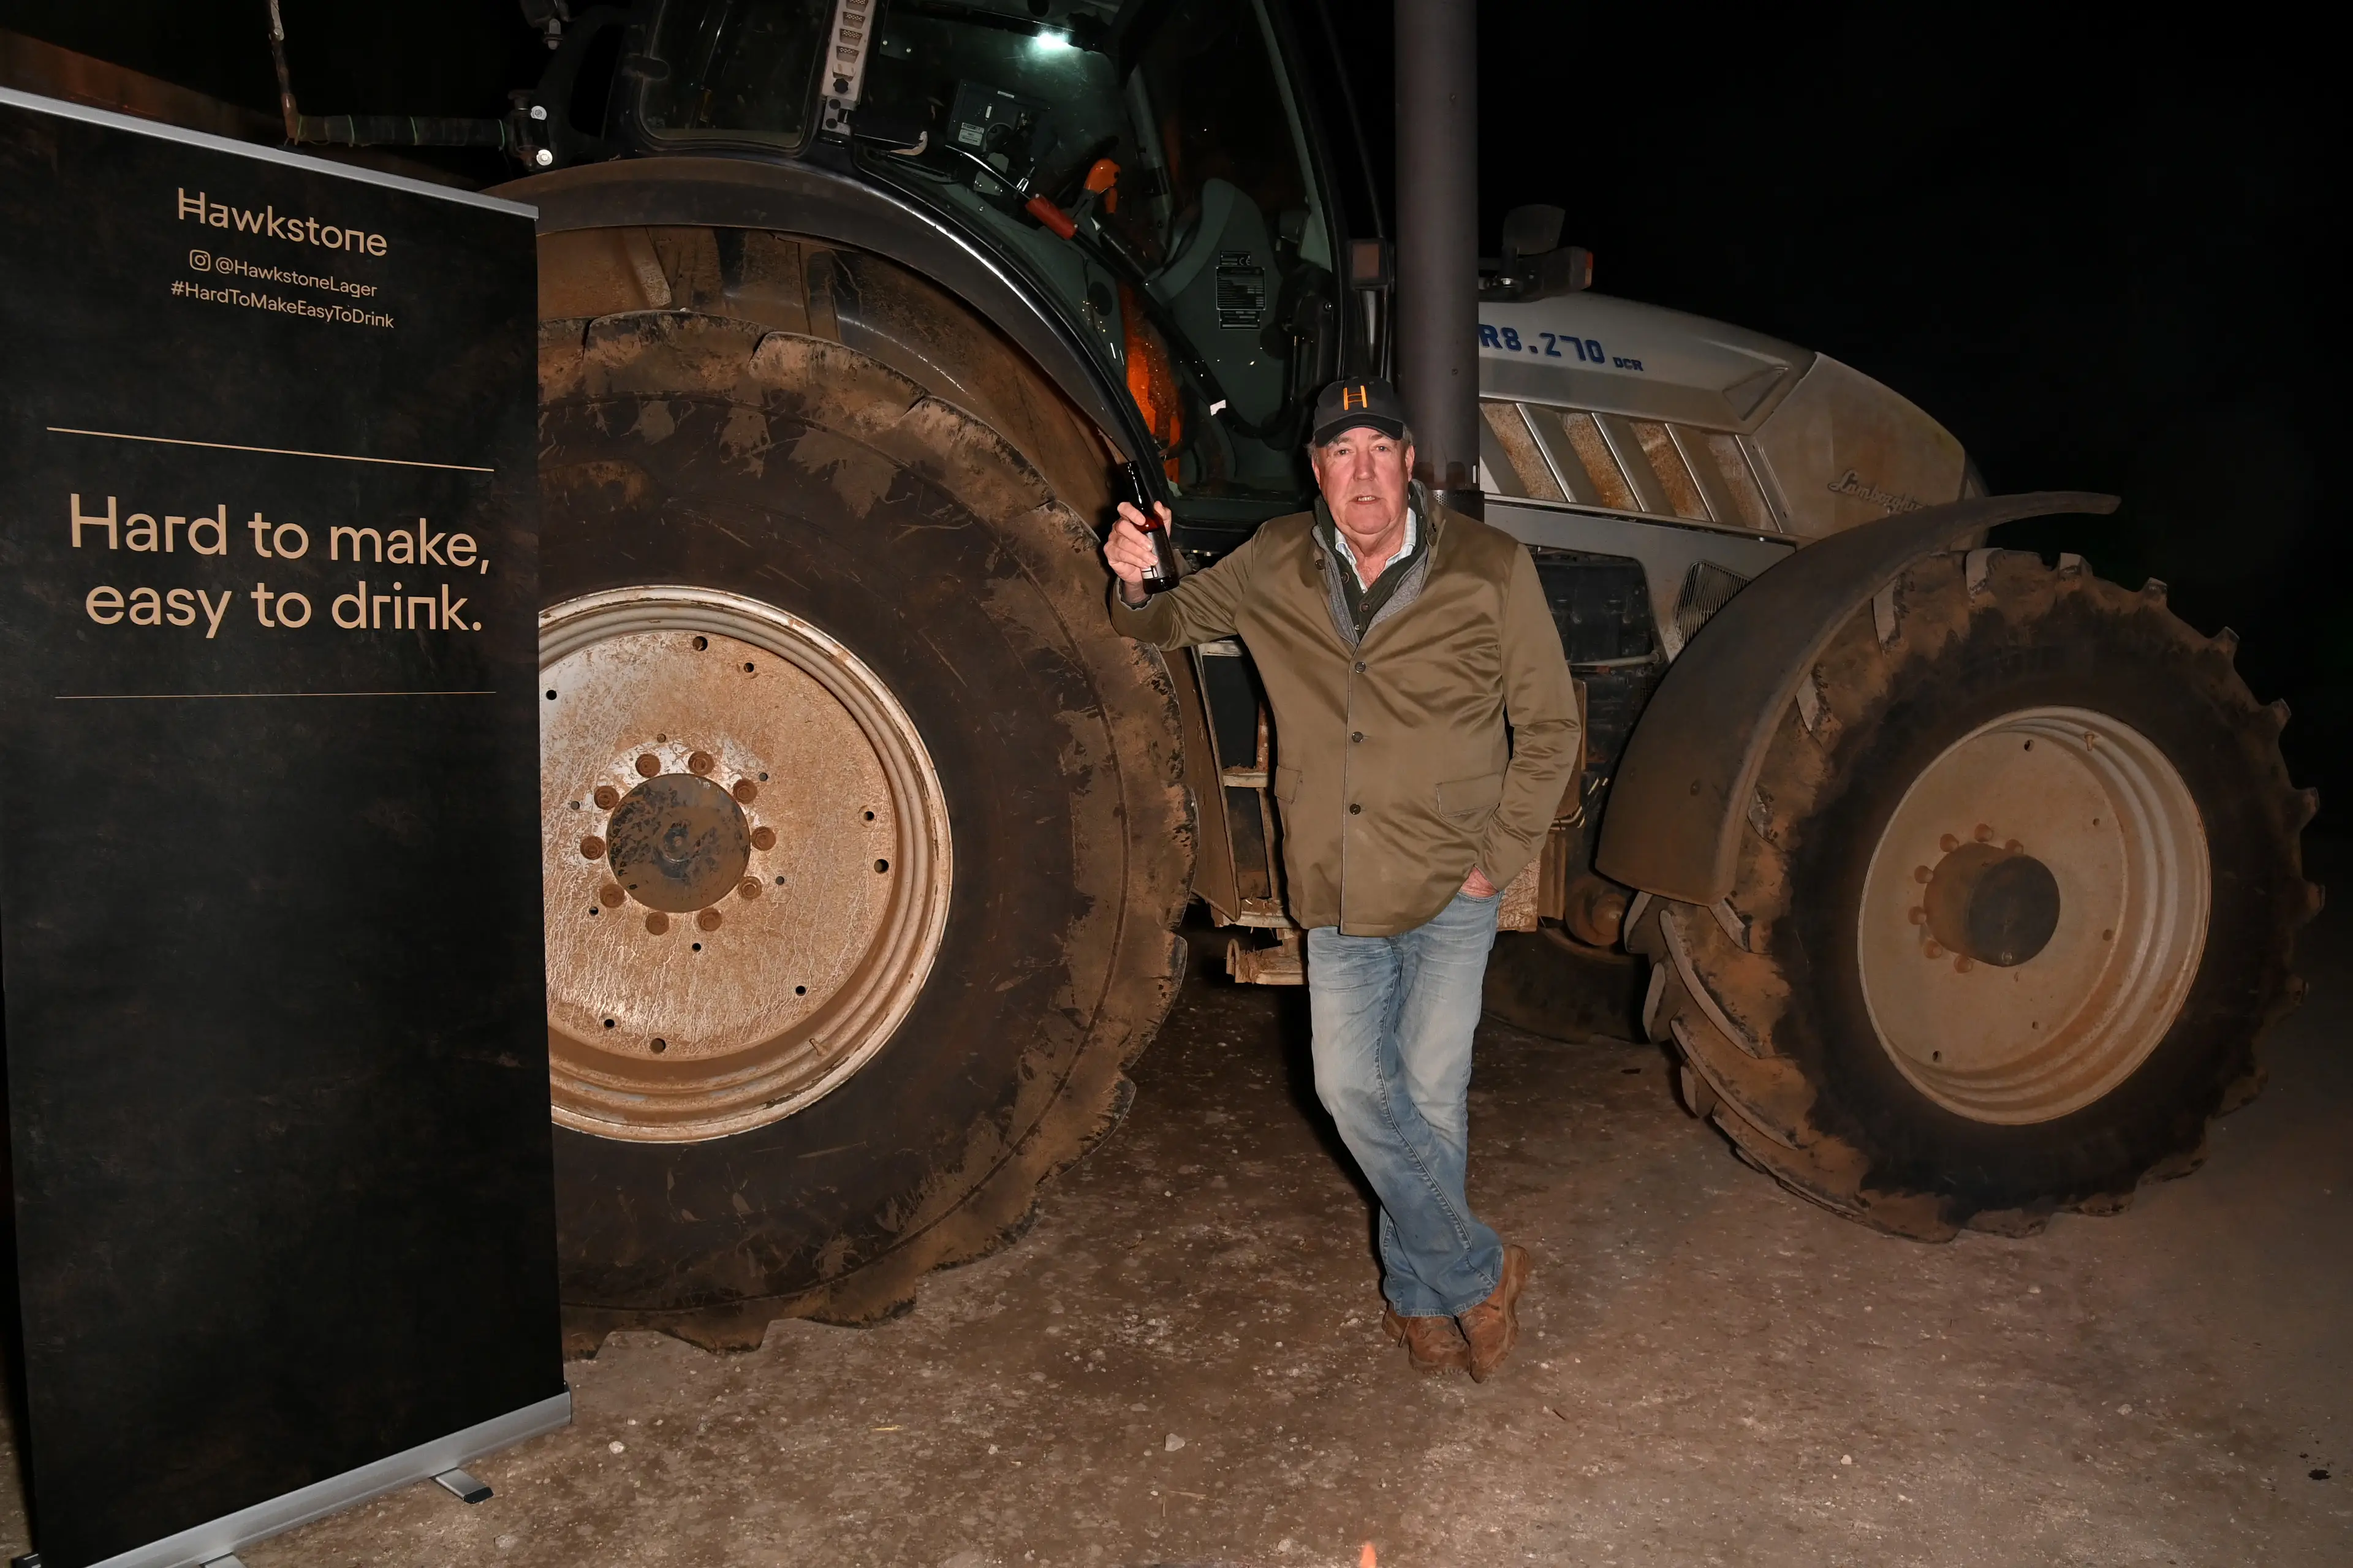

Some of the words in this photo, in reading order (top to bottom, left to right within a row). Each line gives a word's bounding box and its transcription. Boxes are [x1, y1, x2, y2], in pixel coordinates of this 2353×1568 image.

[178, 187, 387, 256] Hawkstone
[215, 257, 378, 298] @HawkstoneLager
[170, 280, 394, 328] #HardToMakeEasyToDrink
[1478, 324, 1605, 365] R8.270
[1612, 357, 1644, 372] DCR
[1343, 385, 1368, 411] H
[70, 493, 227, 555] Hard
[248, 512, 309, 559] to
[330, 517, 490, 575] make,
[85, 585, 232, 638] easy
[250, 582, 312, 628] to
[332, 580, 482, 631] drink.
